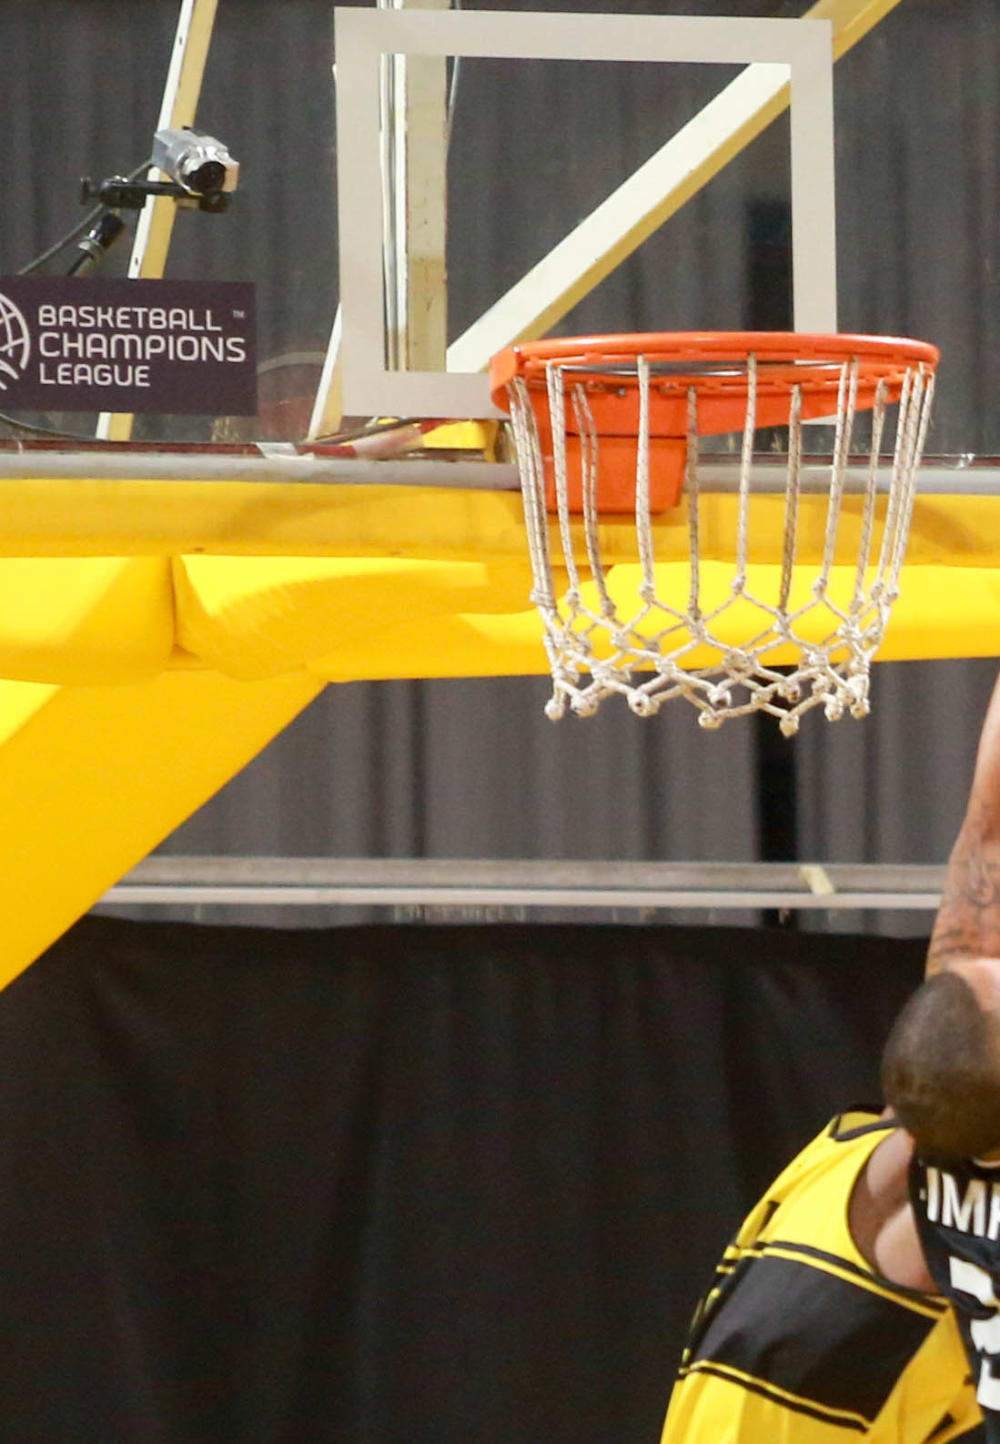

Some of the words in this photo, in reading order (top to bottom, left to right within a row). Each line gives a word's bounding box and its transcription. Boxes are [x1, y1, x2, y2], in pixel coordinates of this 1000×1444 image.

[38, 305, 222, 331] BASKETBALL
[39, 332, 246, 363] CHAMPIONS
[39, 363, 151, 387] LEAGUE
